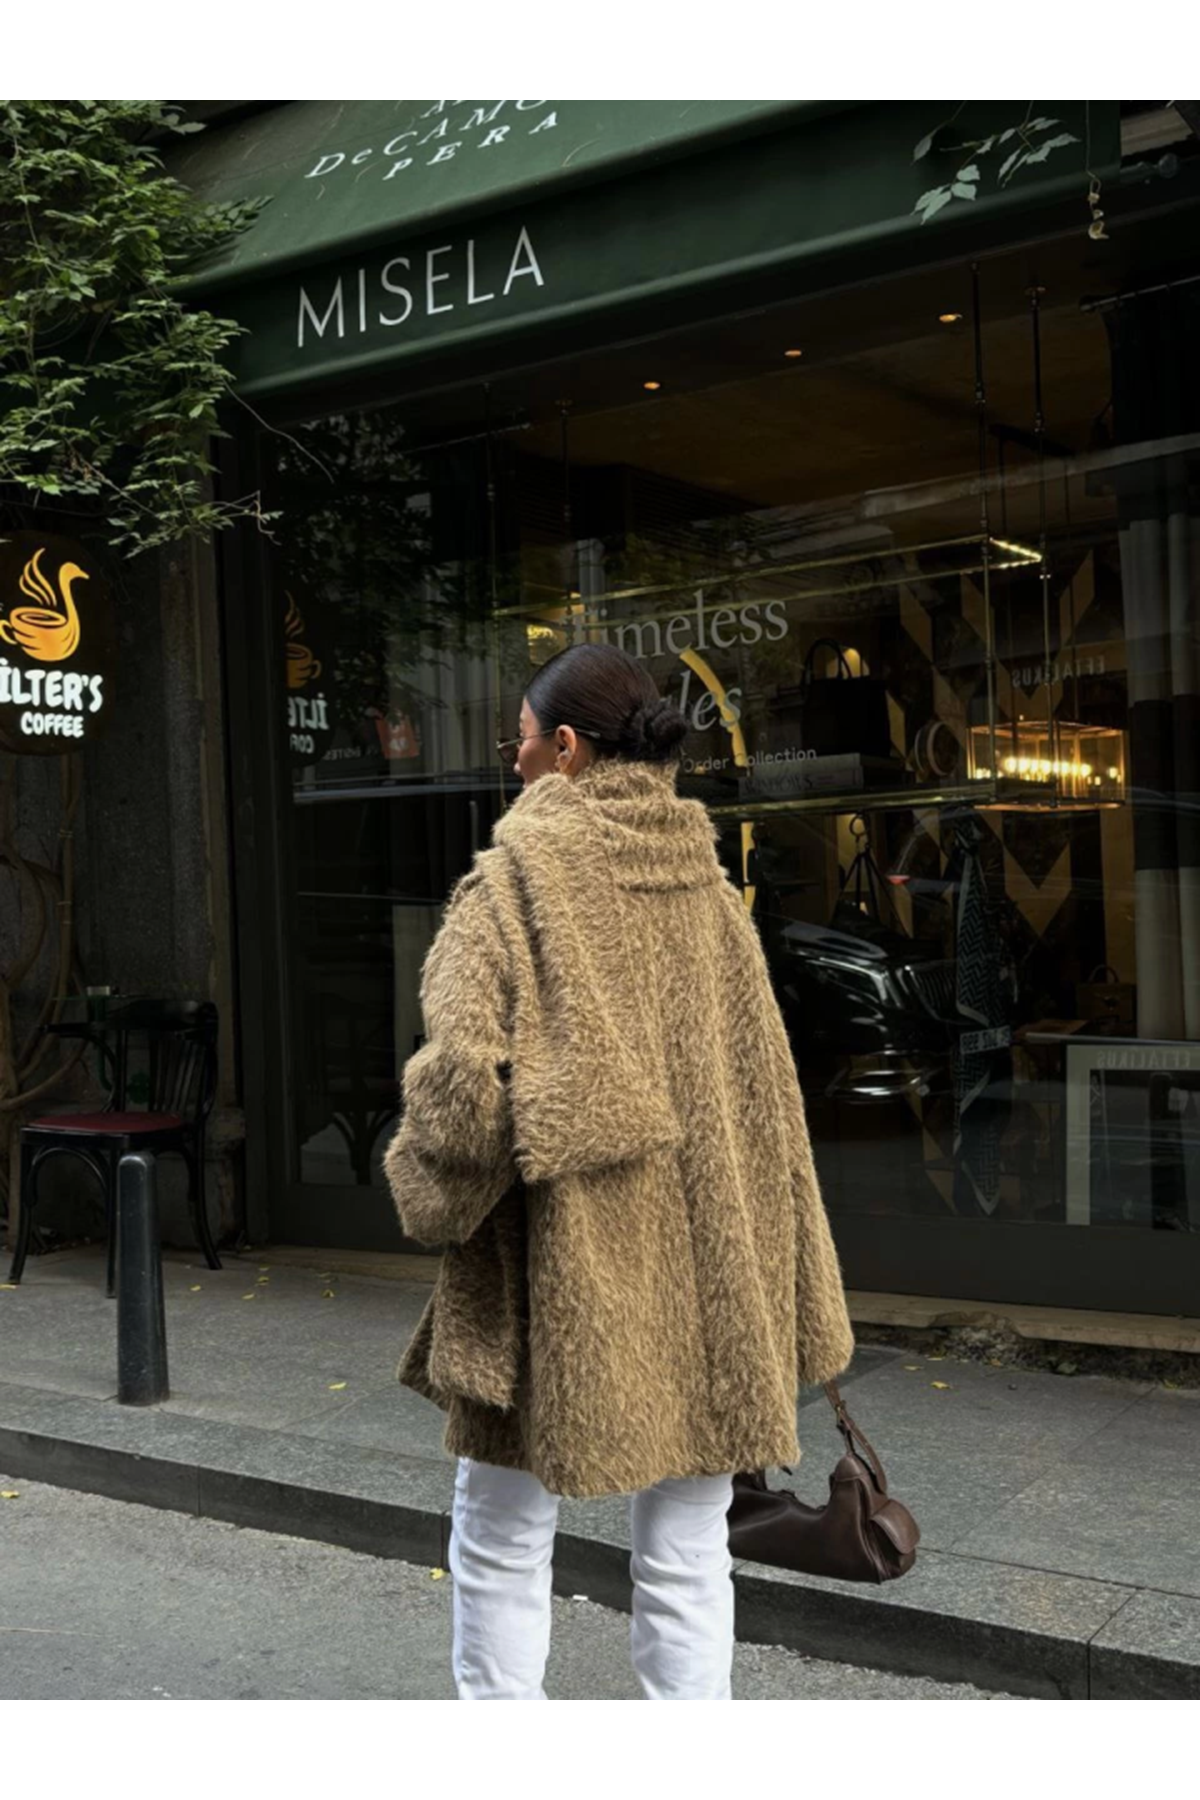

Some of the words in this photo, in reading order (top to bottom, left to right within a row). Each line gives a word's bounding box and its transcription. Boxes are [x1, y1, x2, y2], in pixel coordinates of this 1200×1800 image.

[382, 111, 558, 181] PERA
[297, 225, 544, 348] MISELA
[20, 711, 84, 738] COFFEE
[683, 756, 730, 774] Order
[736, 746, 817, 768] ollection
